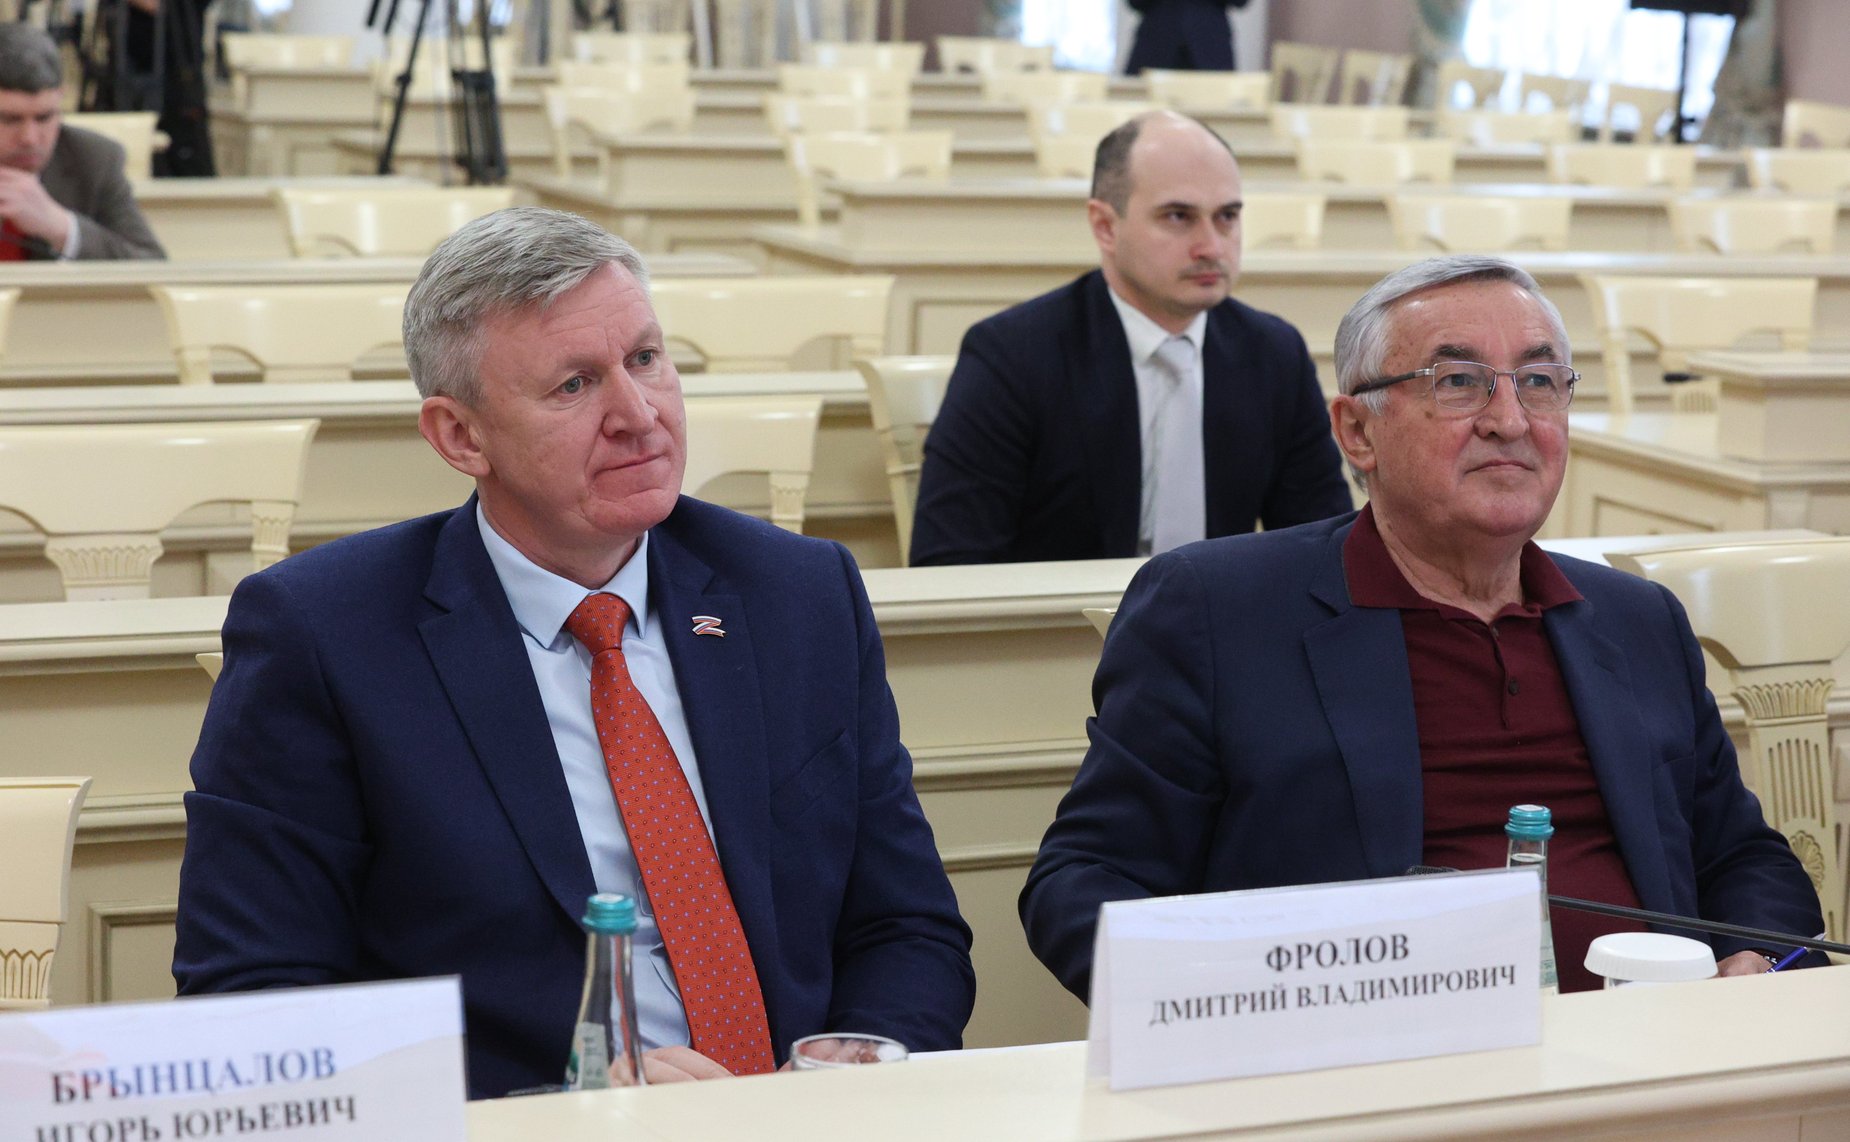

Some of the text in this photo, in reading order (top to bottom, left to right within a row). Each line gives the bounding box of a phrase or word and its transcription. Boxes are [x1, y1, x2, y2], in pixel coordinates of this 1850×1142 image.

[1266, 933, 1410, 973] ФРОЛОВ
[1149, 984, 1288, 1026] ДМИТРИЙ
[1298, 964, 1517, 1008] ВЛАДИМИРОВИЧ
[51, 1047, 337, 1105] БРЫНЦАЛОВ
[36, 1096, 358, 1142] ИГОРЬ ЮРЬЕВИЧ
